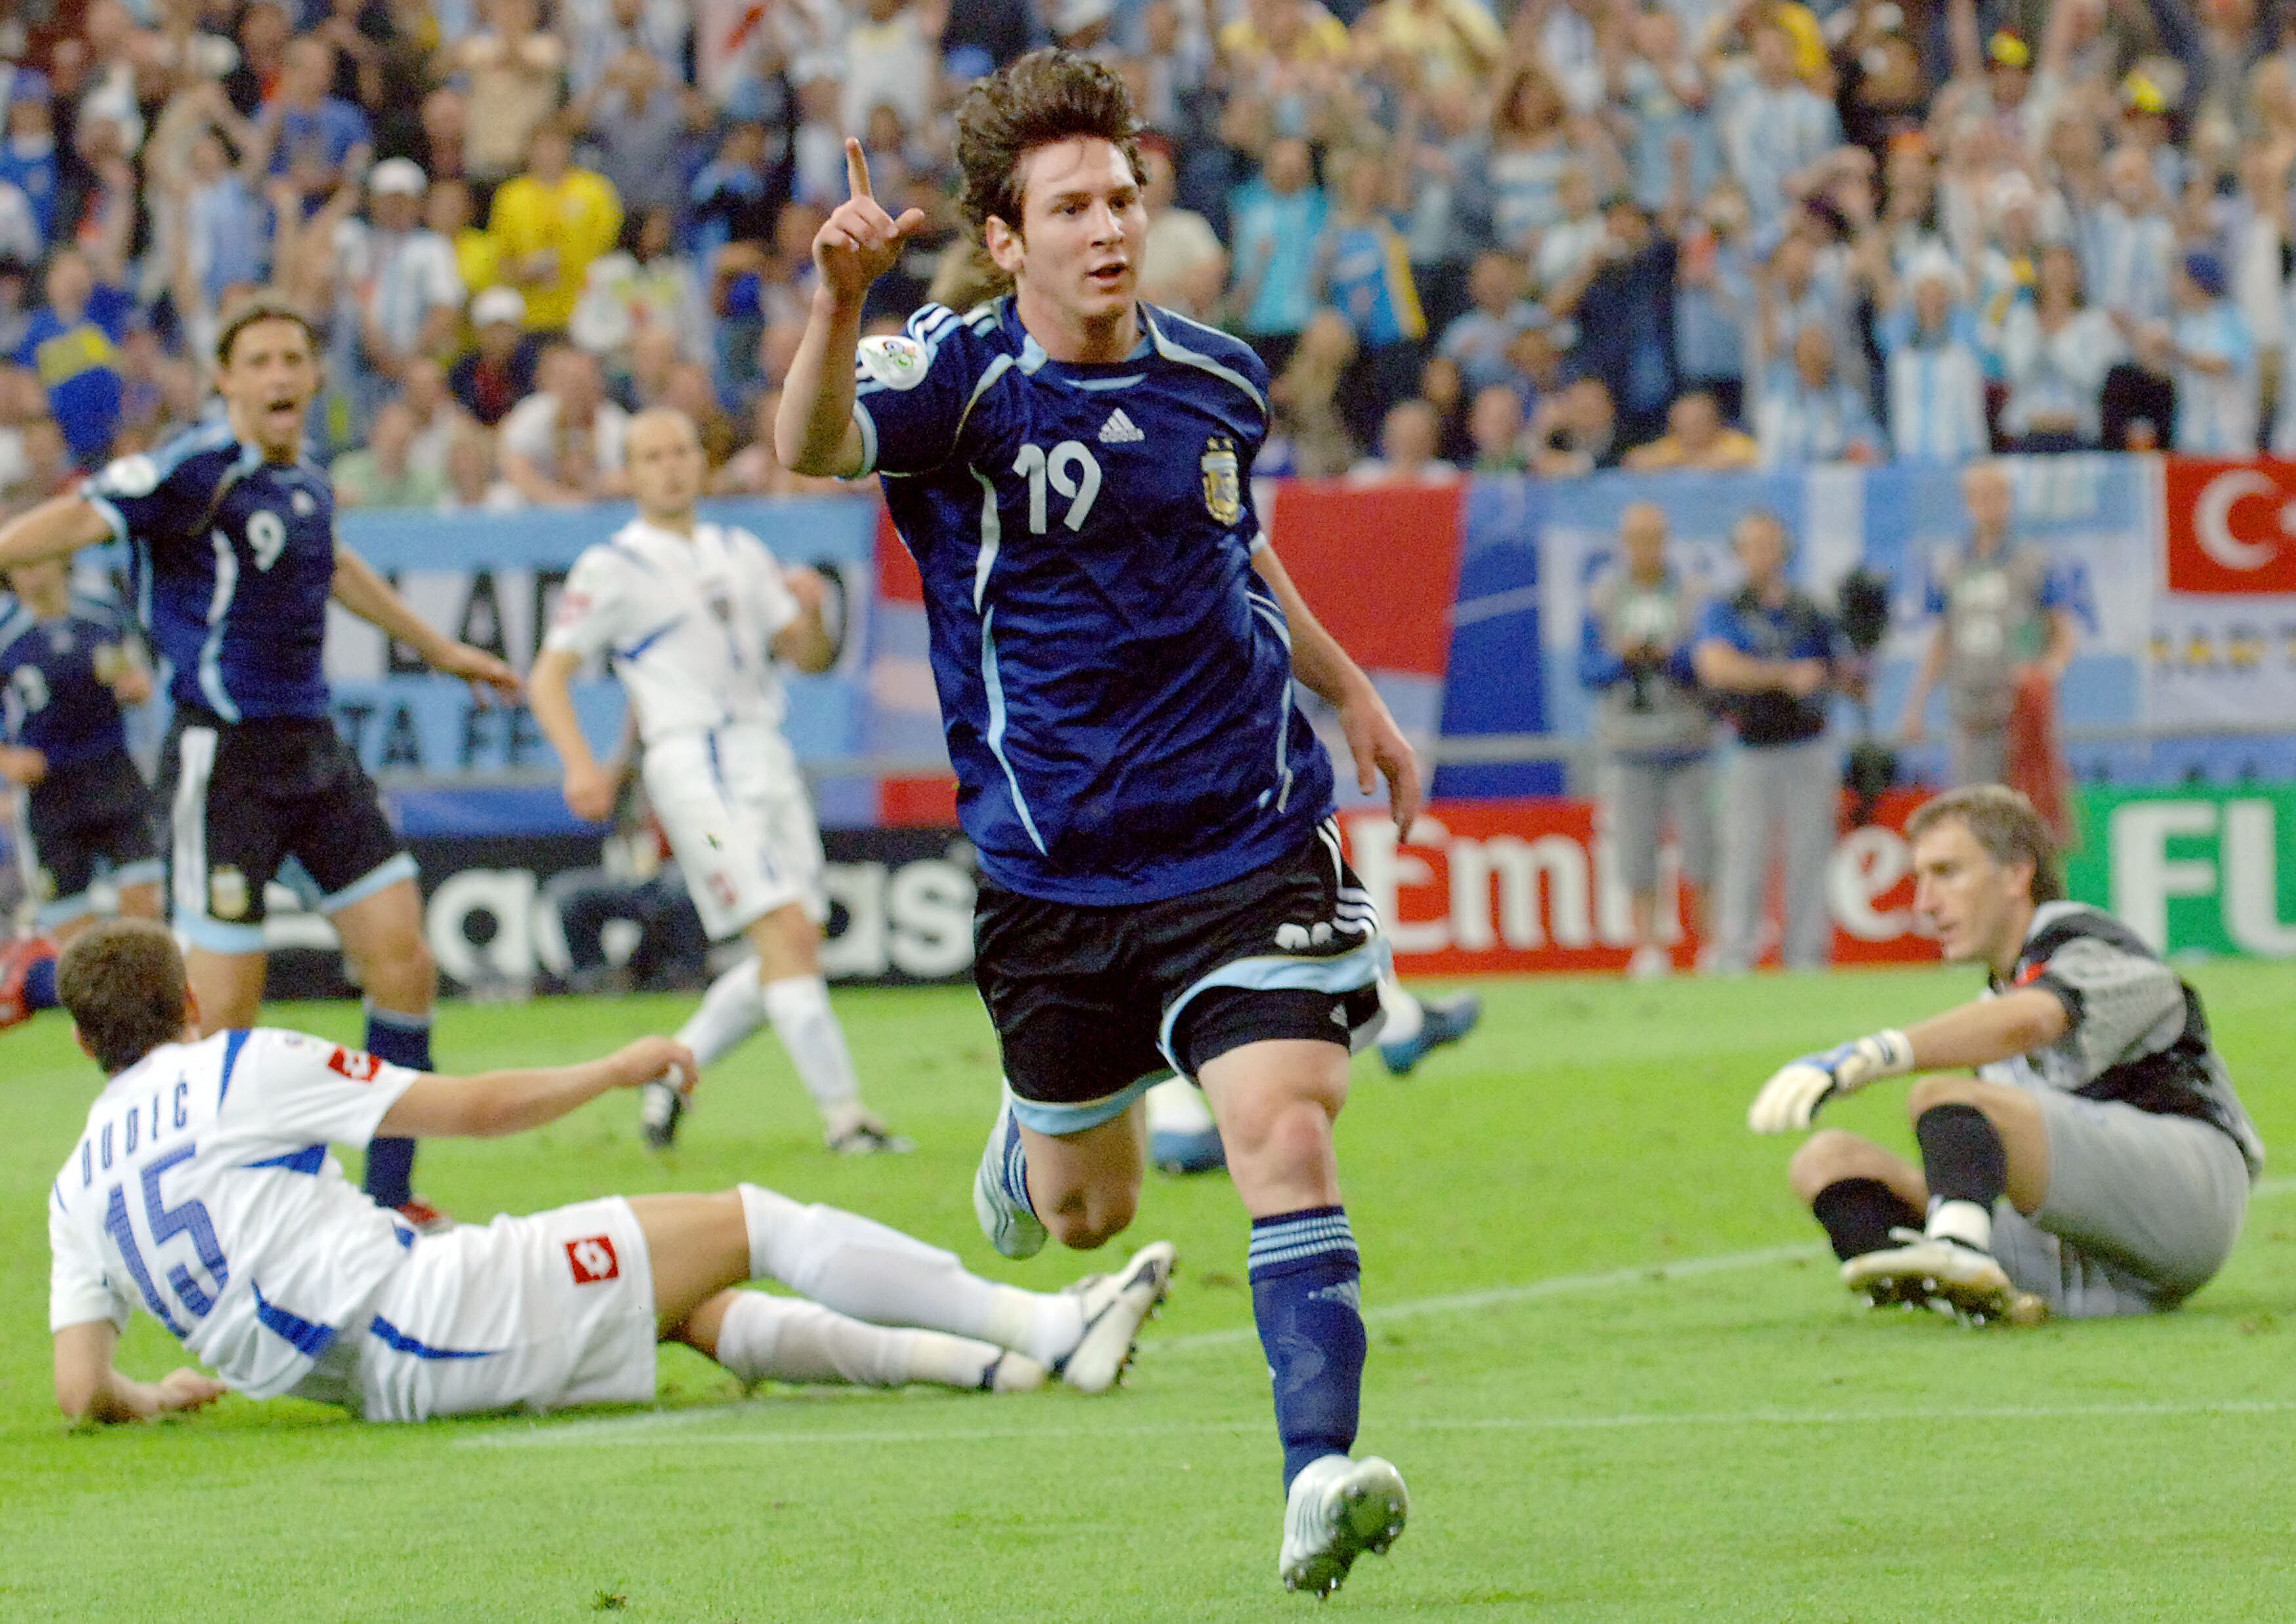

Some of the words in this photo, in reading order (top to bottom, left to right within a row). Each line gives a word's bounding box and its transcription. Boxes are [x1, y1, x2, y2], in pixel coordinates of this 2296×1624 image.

[1012, 439, 1103, 535] 19
[245, 509, 287, 573] 9
[104, 1143, 230, 1340] 15
